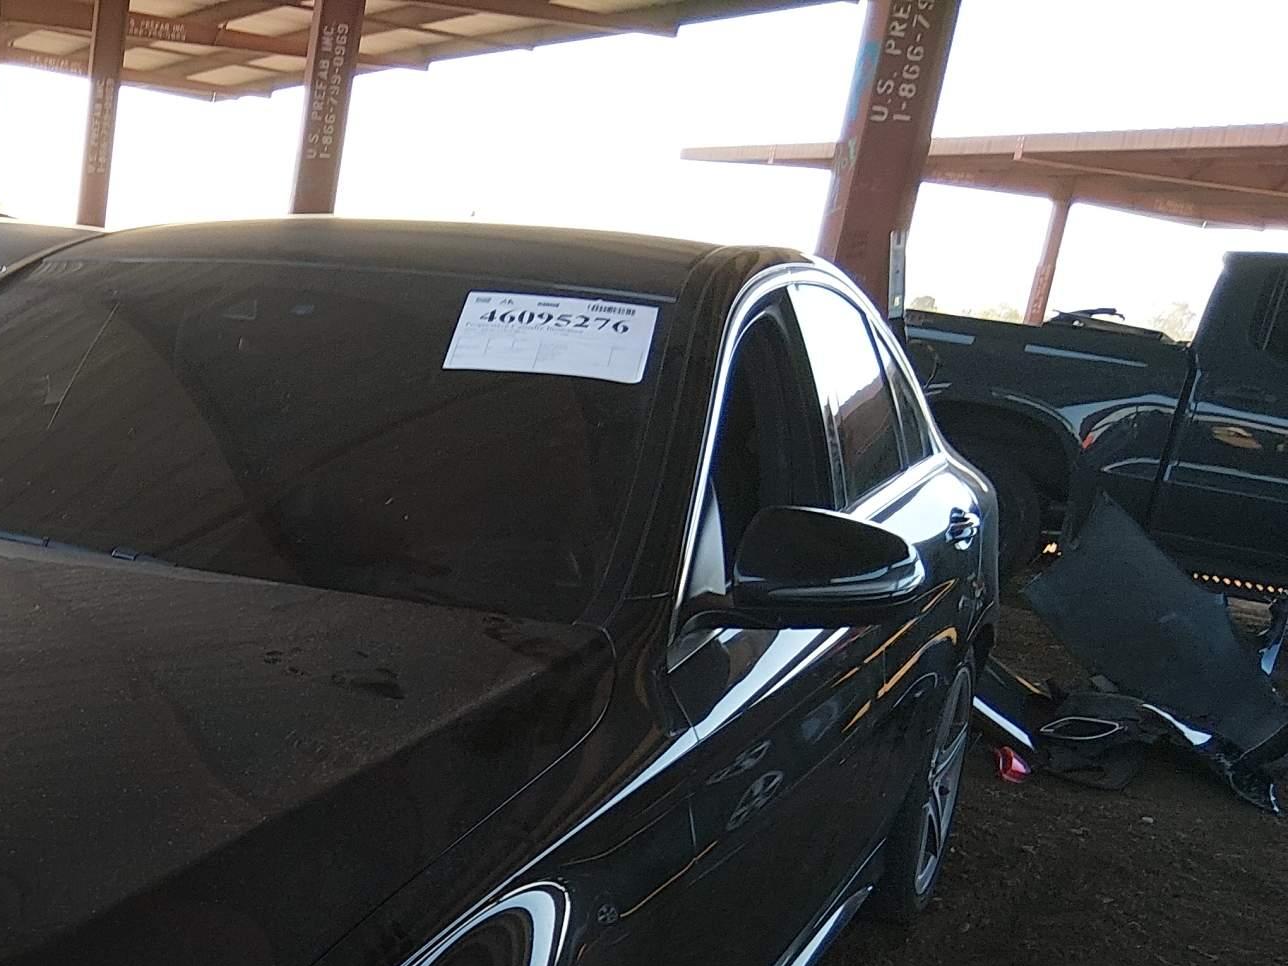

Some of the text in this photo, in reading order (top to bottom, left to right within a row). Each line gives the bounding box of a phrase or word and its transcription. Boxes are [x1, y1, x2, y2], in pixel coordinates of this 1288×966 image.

[311, 59, 330, 121] PREFAB
[319, 23, 349, 159] 1-866-799-0969
[870, 0, 913, 122] U.S. PRE
[479, 308, 631, 335] 46095276
